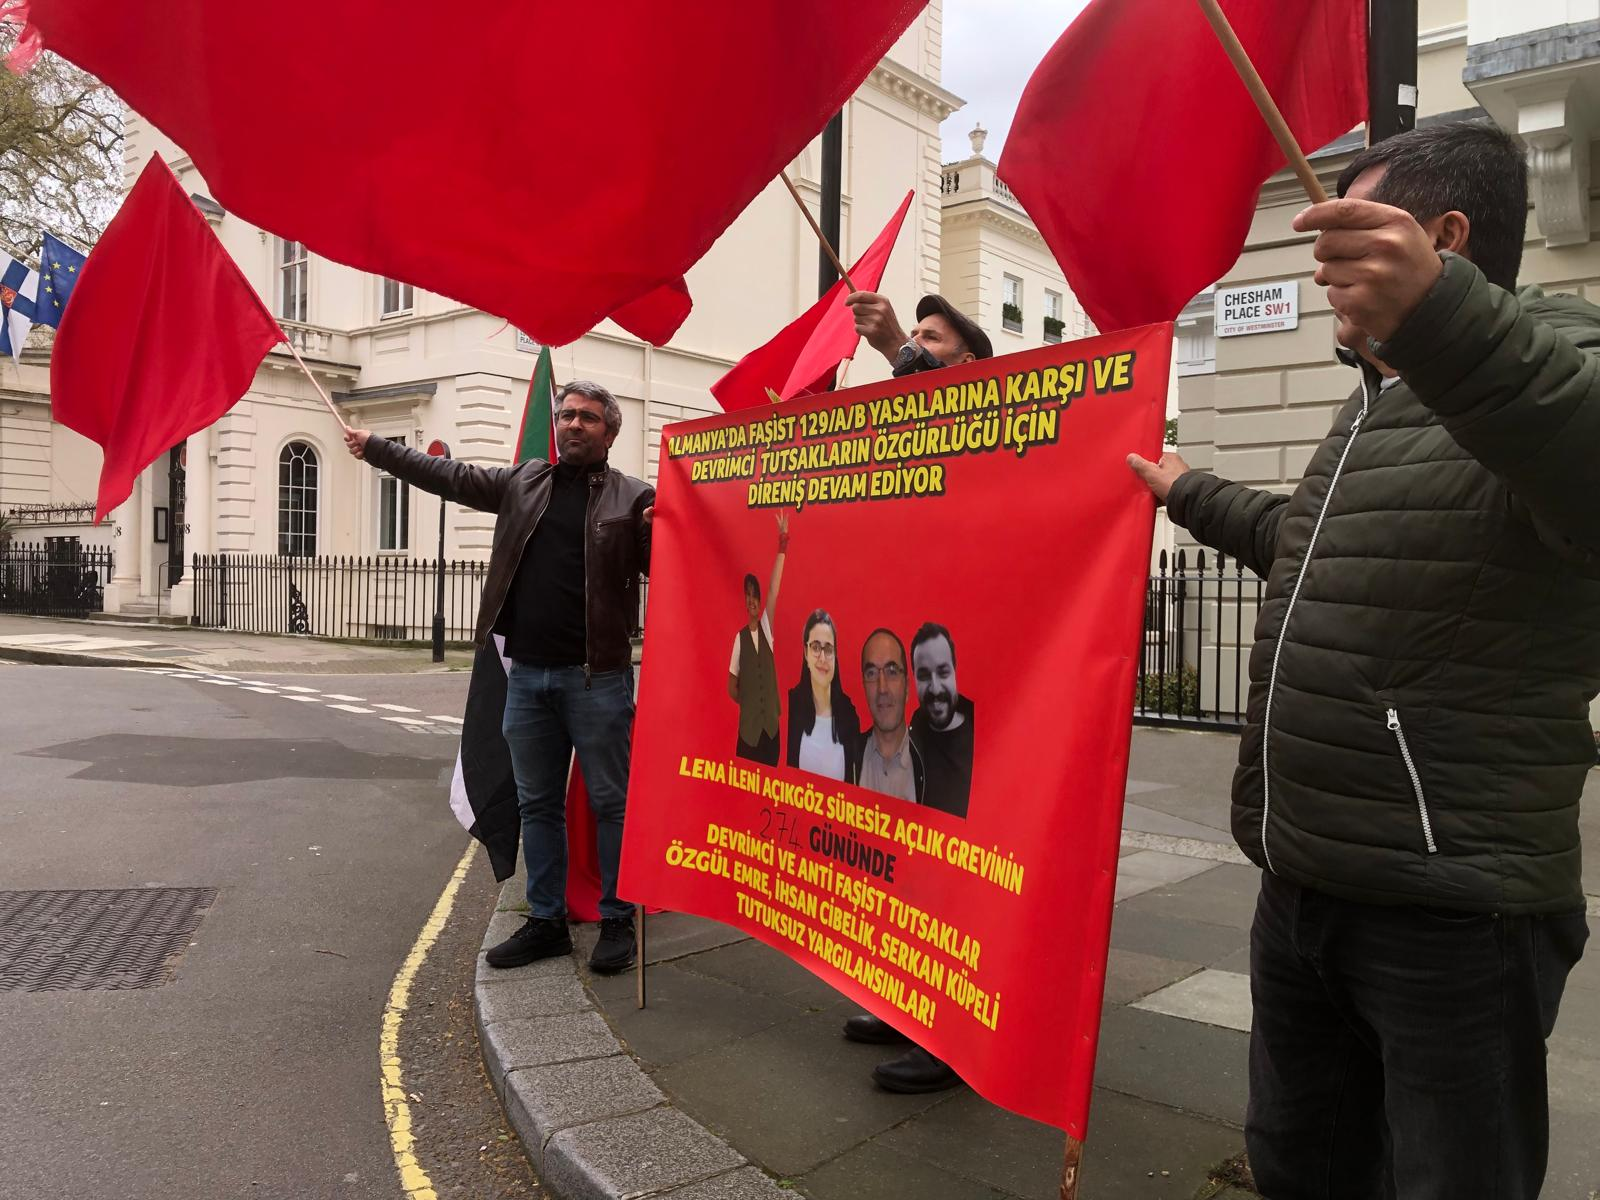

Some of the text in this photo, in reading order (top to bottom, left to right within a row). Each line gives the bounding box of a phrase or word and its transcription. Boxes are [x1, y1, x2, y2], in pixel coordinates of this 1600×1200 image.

[1224, 287, 1282, 306] CHESHAM
[1224, 302, 1291, 321] PLACE SW1
[1246, 321, 1285, 331] WESTMINSTER
[749, 413, 796, 450] FAŞİST
[799, 404, 866, 438] 129/A/B
[868, 379, 1000, 426] YASALARINA
[1005, 362, 1084, 405] KARŞI
[1093, 353, 1132, 390] VE
[691, 404, 1057, 481] DEVRİMCİ TUTSAKLARIN ÖZGÜRLÜĞÜ İÇİN
[748, 462, 943, 510] DİRENİŞ DEVAM EDİYOR
[679, 756, 1025, 895] LENA İLENİ AÇIKGÖZ SÜRESİZ AÇLIK GREVİNİN
[759, 808, 897, 884] 274 GÜNÜNDE
[665, 839, 1001, 1032] ÖZGÜL EMRE, İHSAN CİBELİK, SERKAN KÜPELİ
[706, 823, 981, 972] DEVRİMCİ VE ANTİ FAŞİST TUTSAKLAR
[736, 891, 937, 1029] TUTUKSUZ YARGILANSINLAR!
